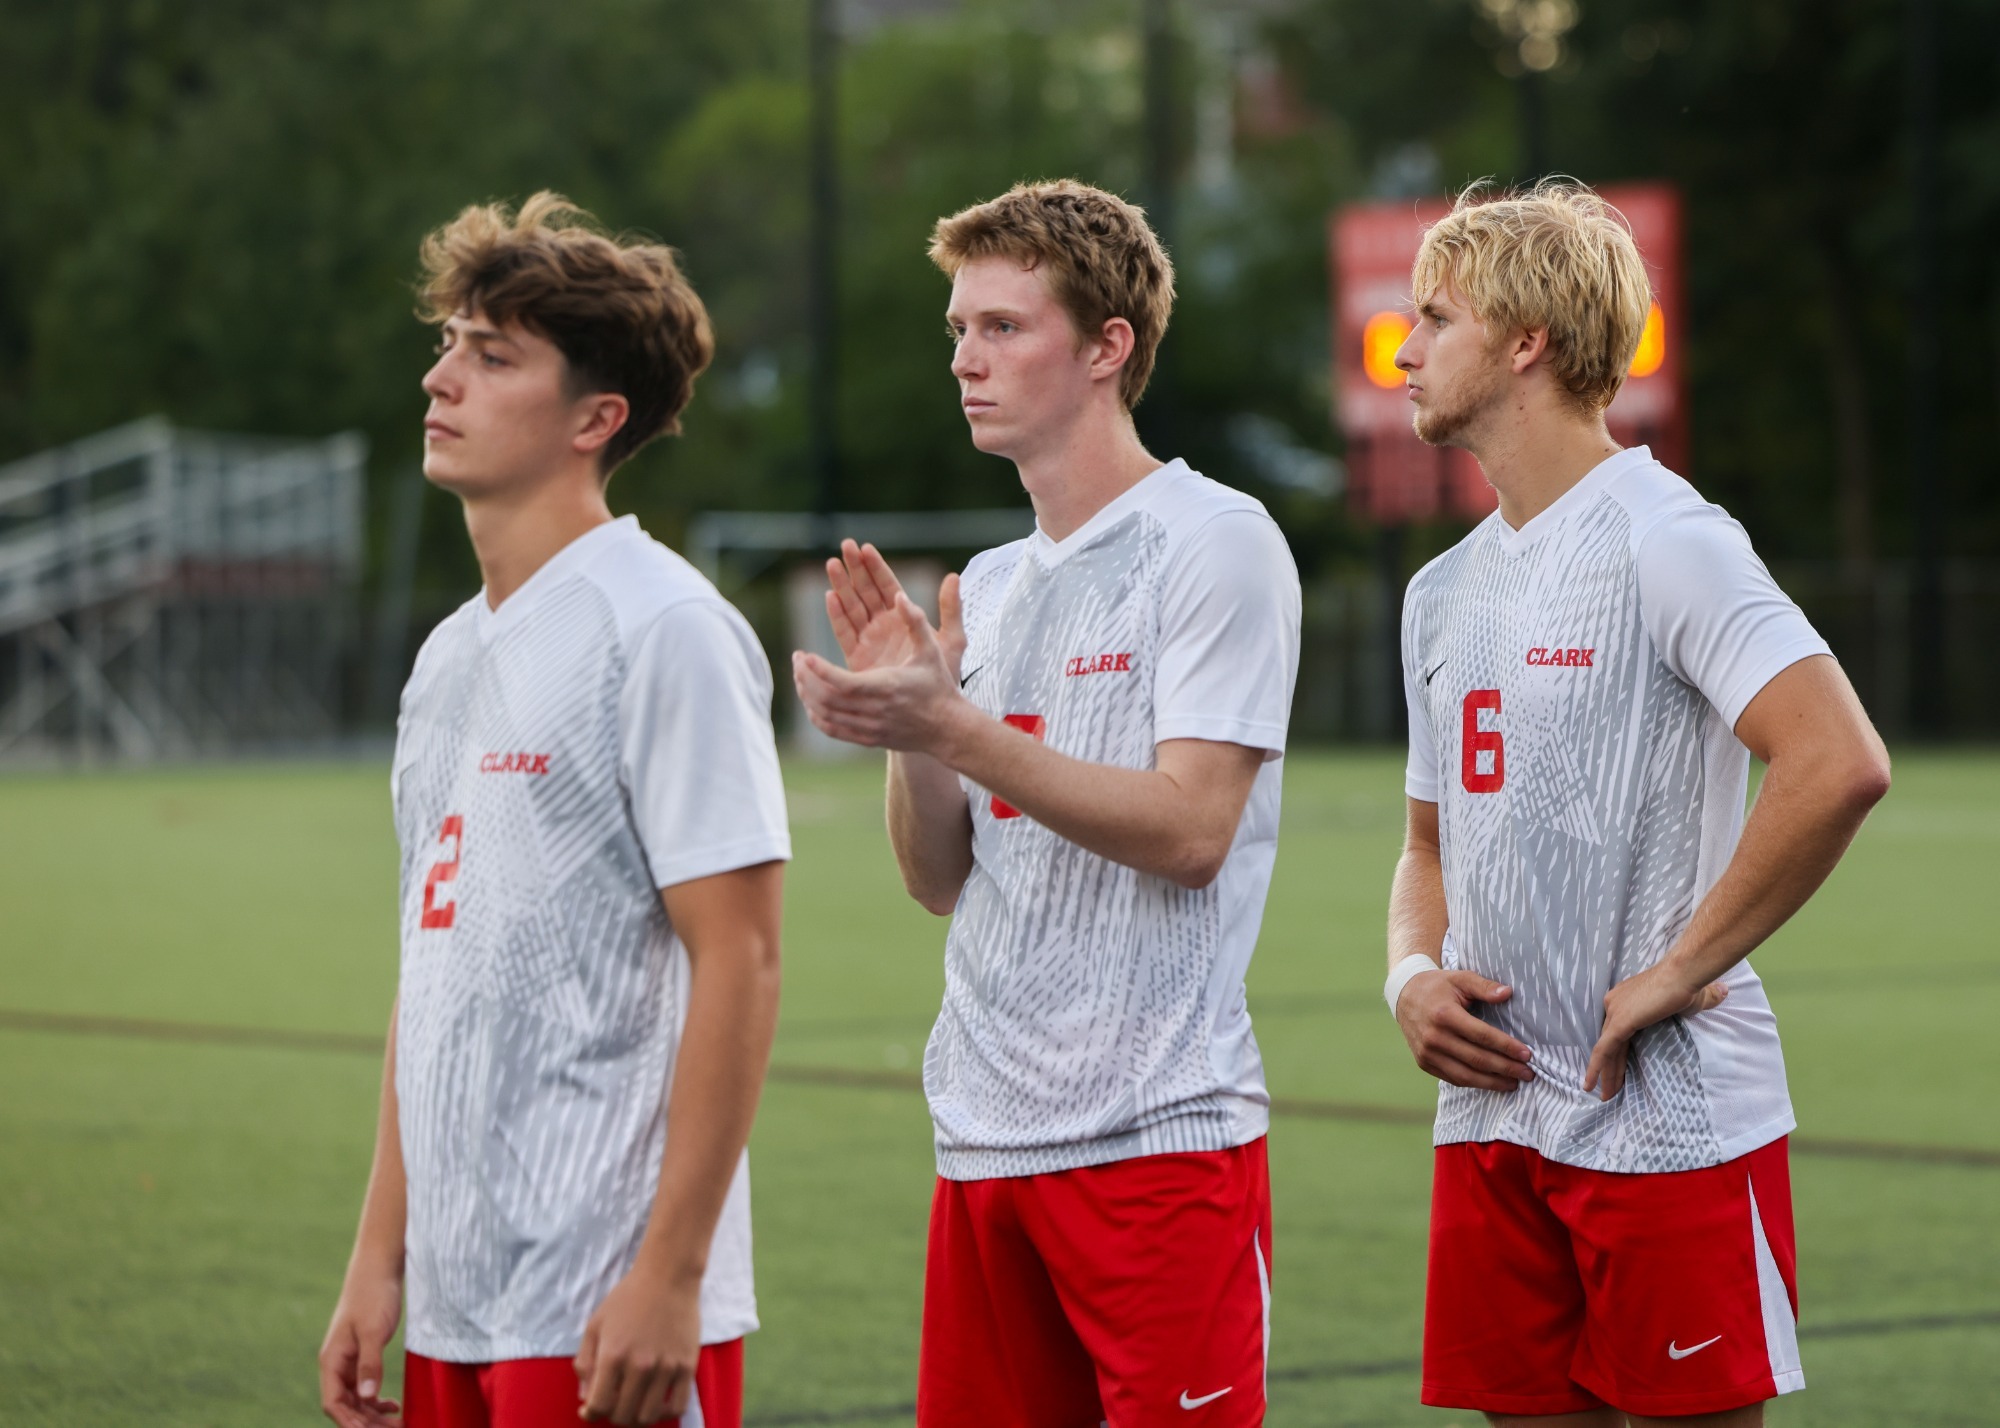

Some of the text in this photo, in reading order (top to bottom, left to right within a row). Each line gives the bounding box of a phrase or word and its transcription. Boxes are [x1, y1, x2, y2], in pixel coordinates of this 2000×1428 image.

[1066, 653, 1132, 677] CLARK
[1526, 648, 1595, 667] CLARK
[1462, 689, 1505, 793] 6
[480, 753, 551, 775] CLARK
[420, 815, 463, 930] 2
